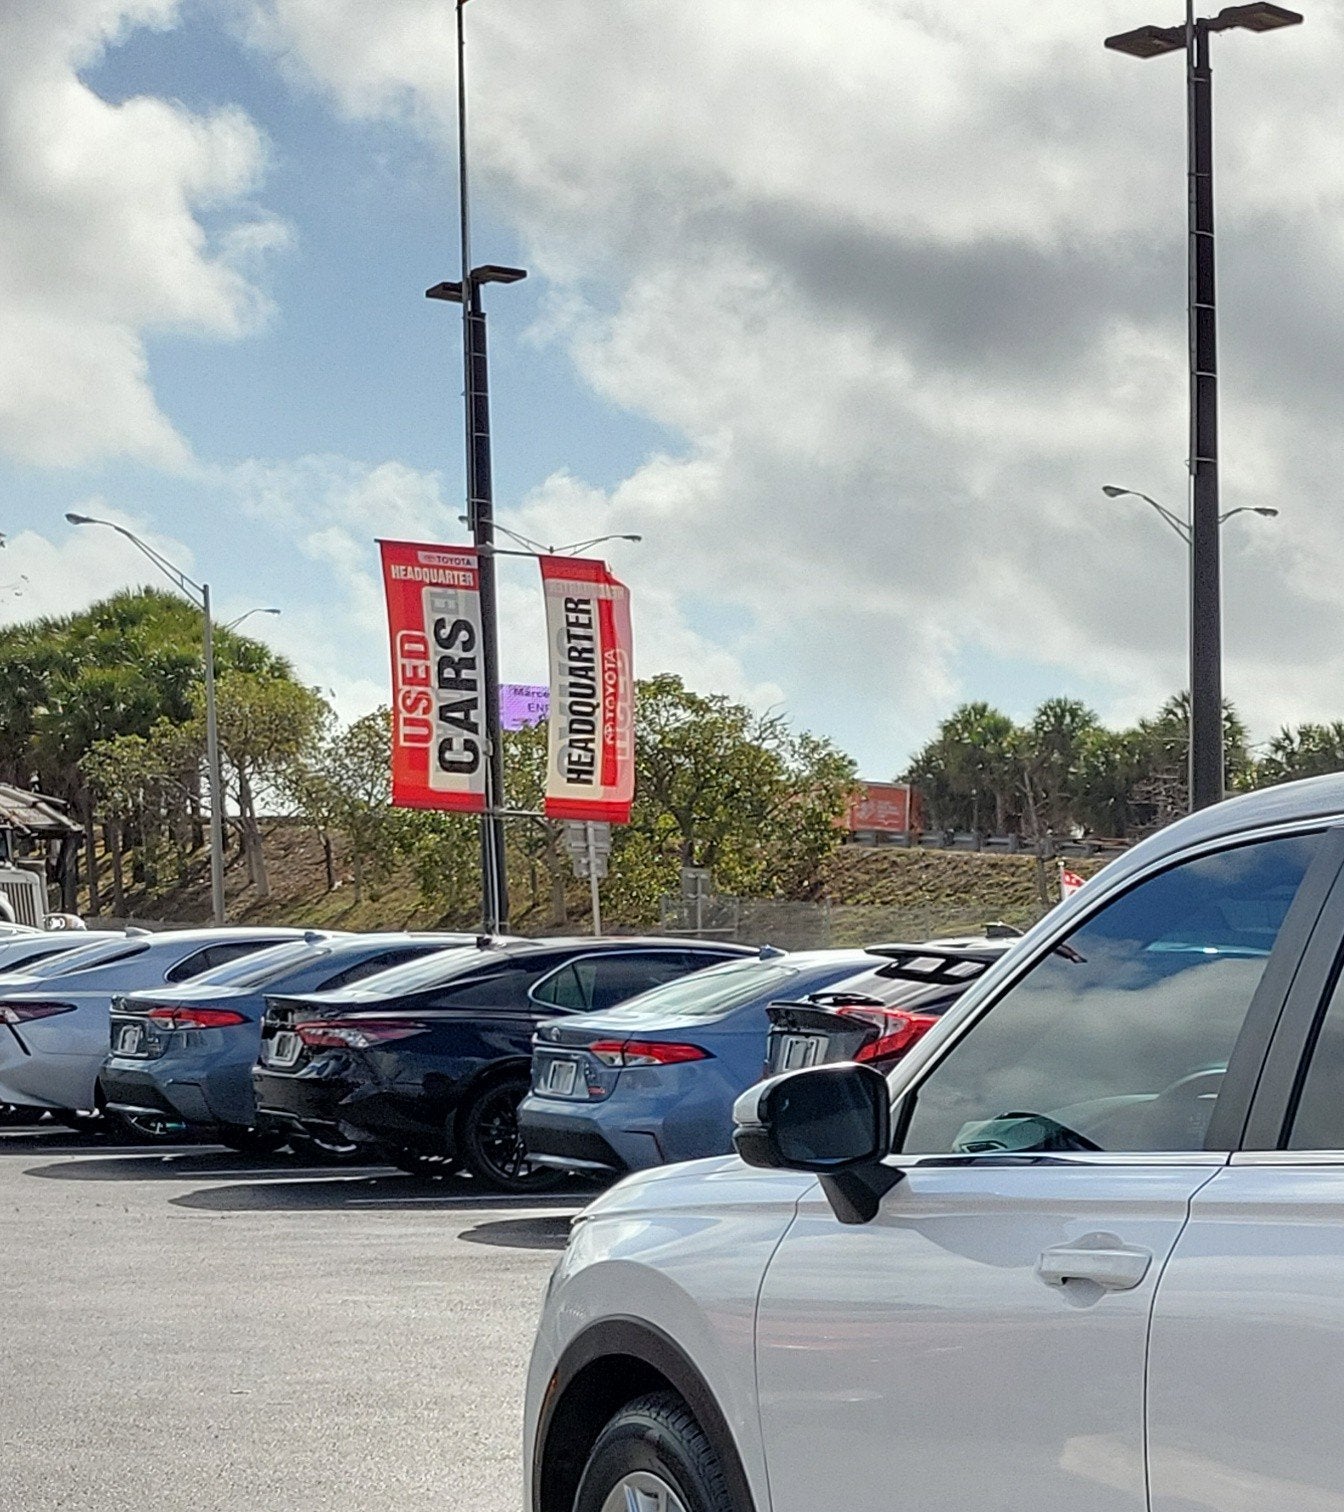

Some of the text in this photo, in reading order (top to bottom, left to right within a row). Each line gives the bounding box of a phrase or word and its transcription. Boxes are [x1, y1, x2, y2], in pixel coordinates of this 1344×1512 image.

[390, 564, 474, 587] HEADQUARTER
[436, 555, 472, 567] TOYOTA
[397, 617, 480, 775] USED CARS
[564, 596, 600, 786] HEADQUARTER
[604, 649, 617, 720] TOYOTA
